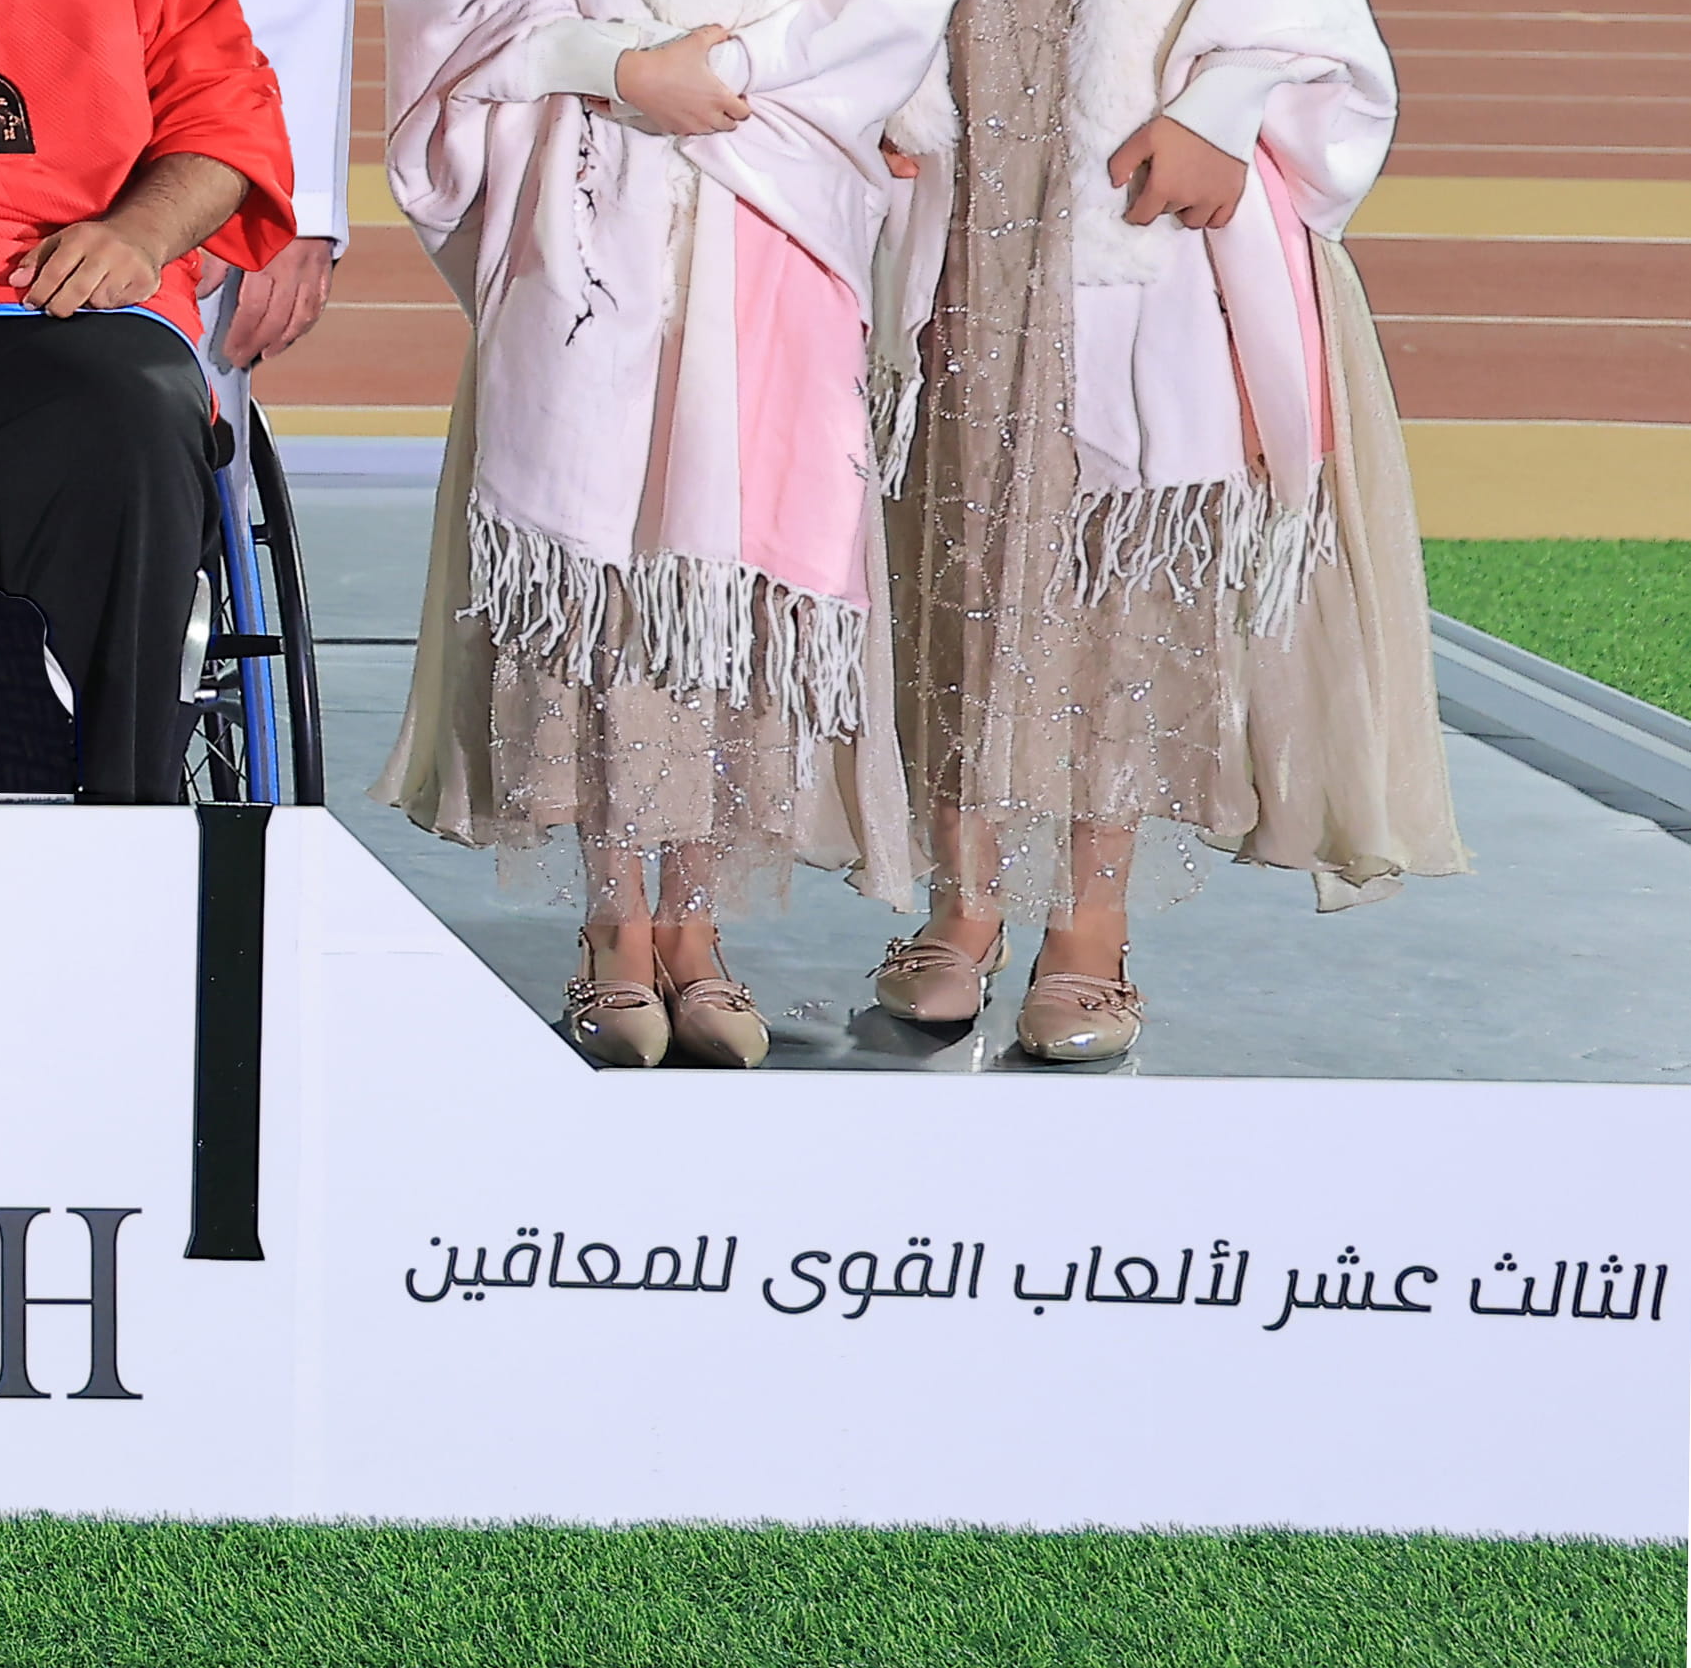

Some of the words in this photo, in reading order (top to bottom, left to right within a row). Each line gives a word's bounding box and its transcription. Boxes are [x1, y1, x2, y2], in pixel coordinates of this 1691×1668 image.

[405, 1227, 738, 1303] للمعاقين
[762, 1236, 985, 1320] القوى
[1013, 1239, 1250, 1316] لألعاب
[1262, 1245, 1439, 1332] عشر
[1470, 1252, 1668, 1321] الثالث
